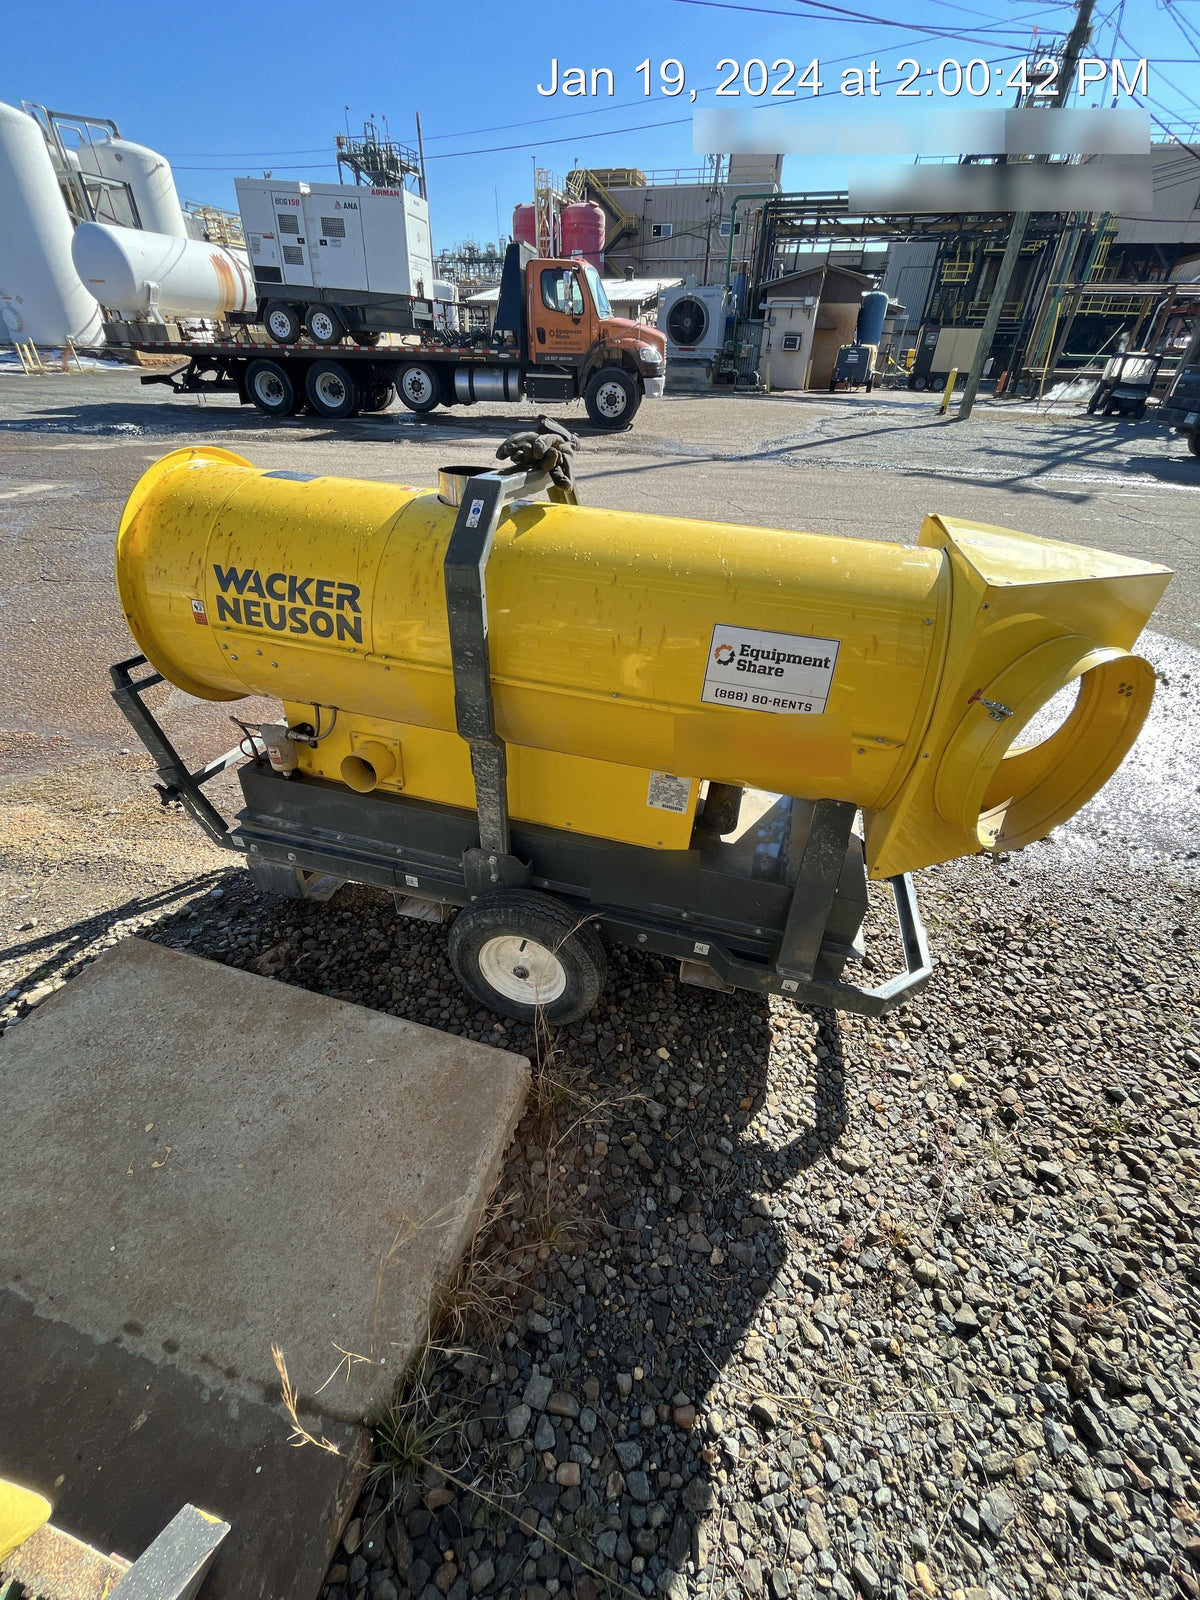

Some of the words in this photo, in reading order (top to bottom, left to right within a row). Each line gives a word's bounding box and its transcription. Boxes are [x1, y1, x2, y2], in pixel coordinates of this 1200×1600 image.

[371, 188, 399, 197] AIRMAN
[343, 202, 358, 210] ANA
[213, 564, 362, 613] WACKER
[216, 595, 363, 644] NEUSON
[736, 659, 784, 677] Share
[739, 644, 831, 669] Equipment
[714, 687, 748, 702] (888)
[752, 694, 813, 712] 80-RENTS
